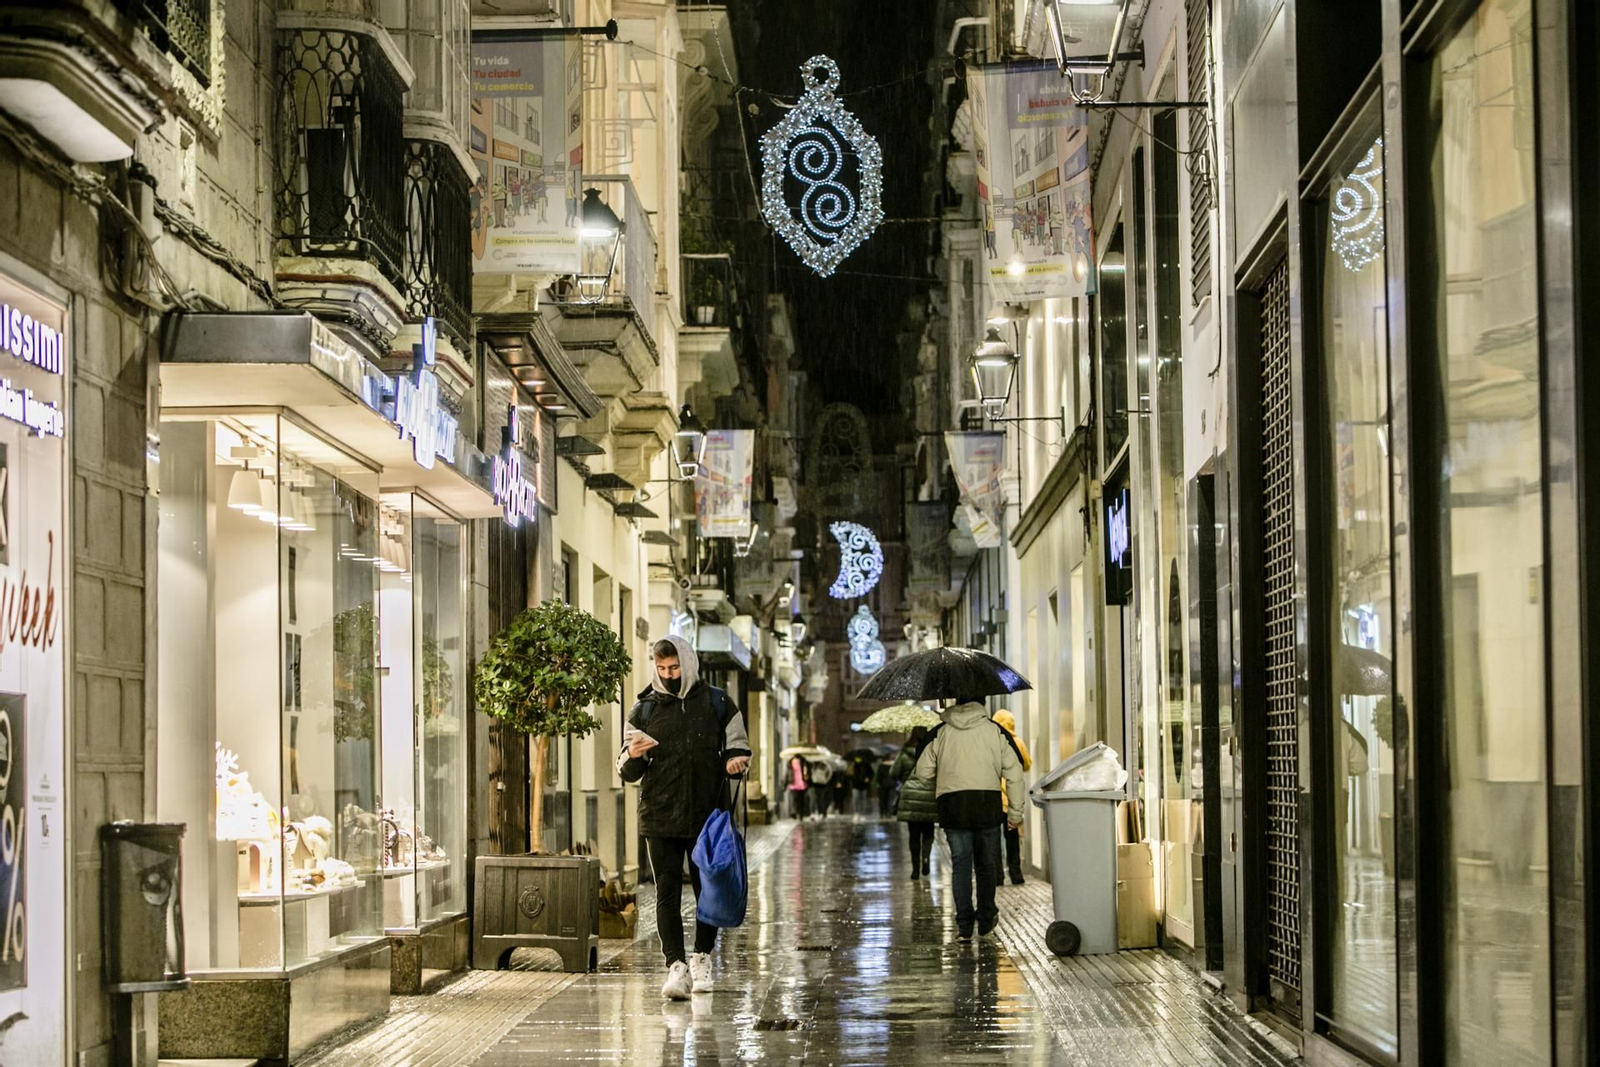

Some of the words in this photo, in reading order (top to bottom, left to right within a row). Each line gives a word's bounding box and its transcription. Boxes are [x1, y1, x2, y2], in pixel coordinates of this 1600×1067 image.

[473, 56, 485, 65] Tu
[488, 56, 509, 65] vida
[473, 69, 486, 78] Tu
[488, 68, 521, 78] ciudad
[473, 82, 486, 91] Tu
[488, 82, 534, 91] comercio
